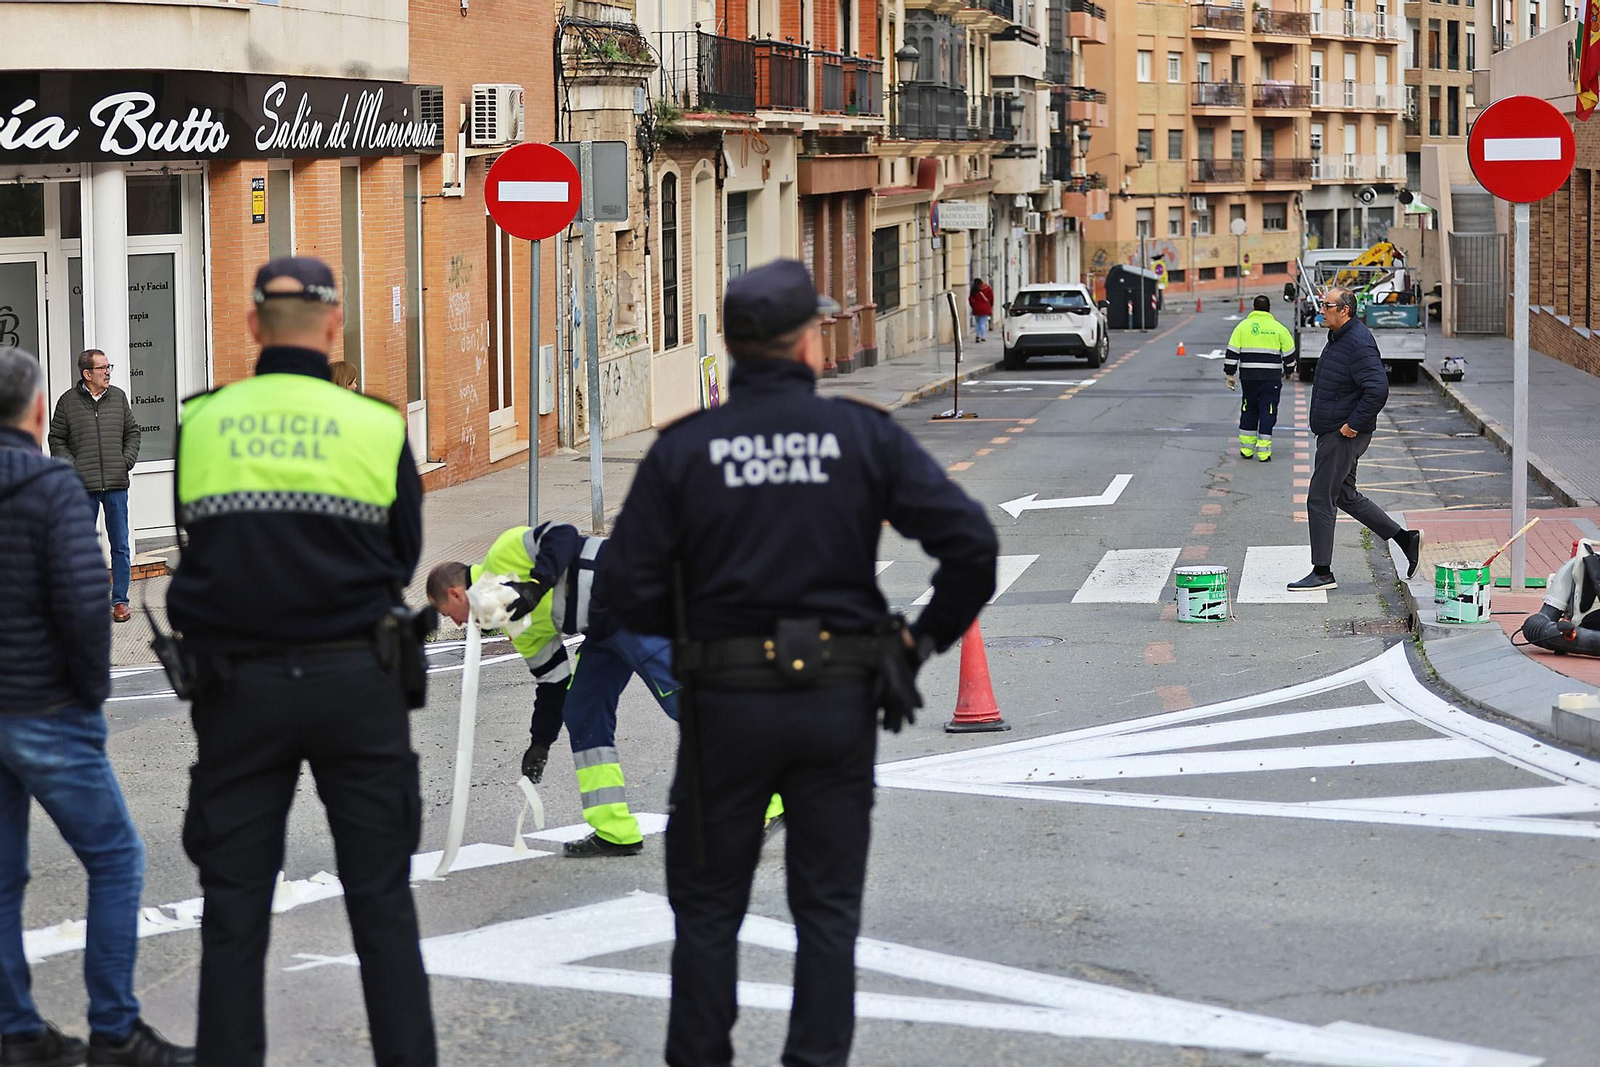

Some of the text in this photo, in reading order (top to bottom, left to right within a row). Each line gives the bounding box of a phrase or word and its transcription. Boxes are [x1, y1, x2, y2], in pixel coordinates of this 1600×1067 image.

[0, 91, 230, 156] ía Butto
[255, 80, 438, 151] Salón de Manicura
[146, 281, 169, 291] Facial
[135, 395, 165, 405] Faciales
[219, 415, 340, 437] POLICIA
[229, 437, 328, 461] LOCAL
[709, 432, 841, 465] POLICIA
[724, 457, 829, 488] LOCAL
